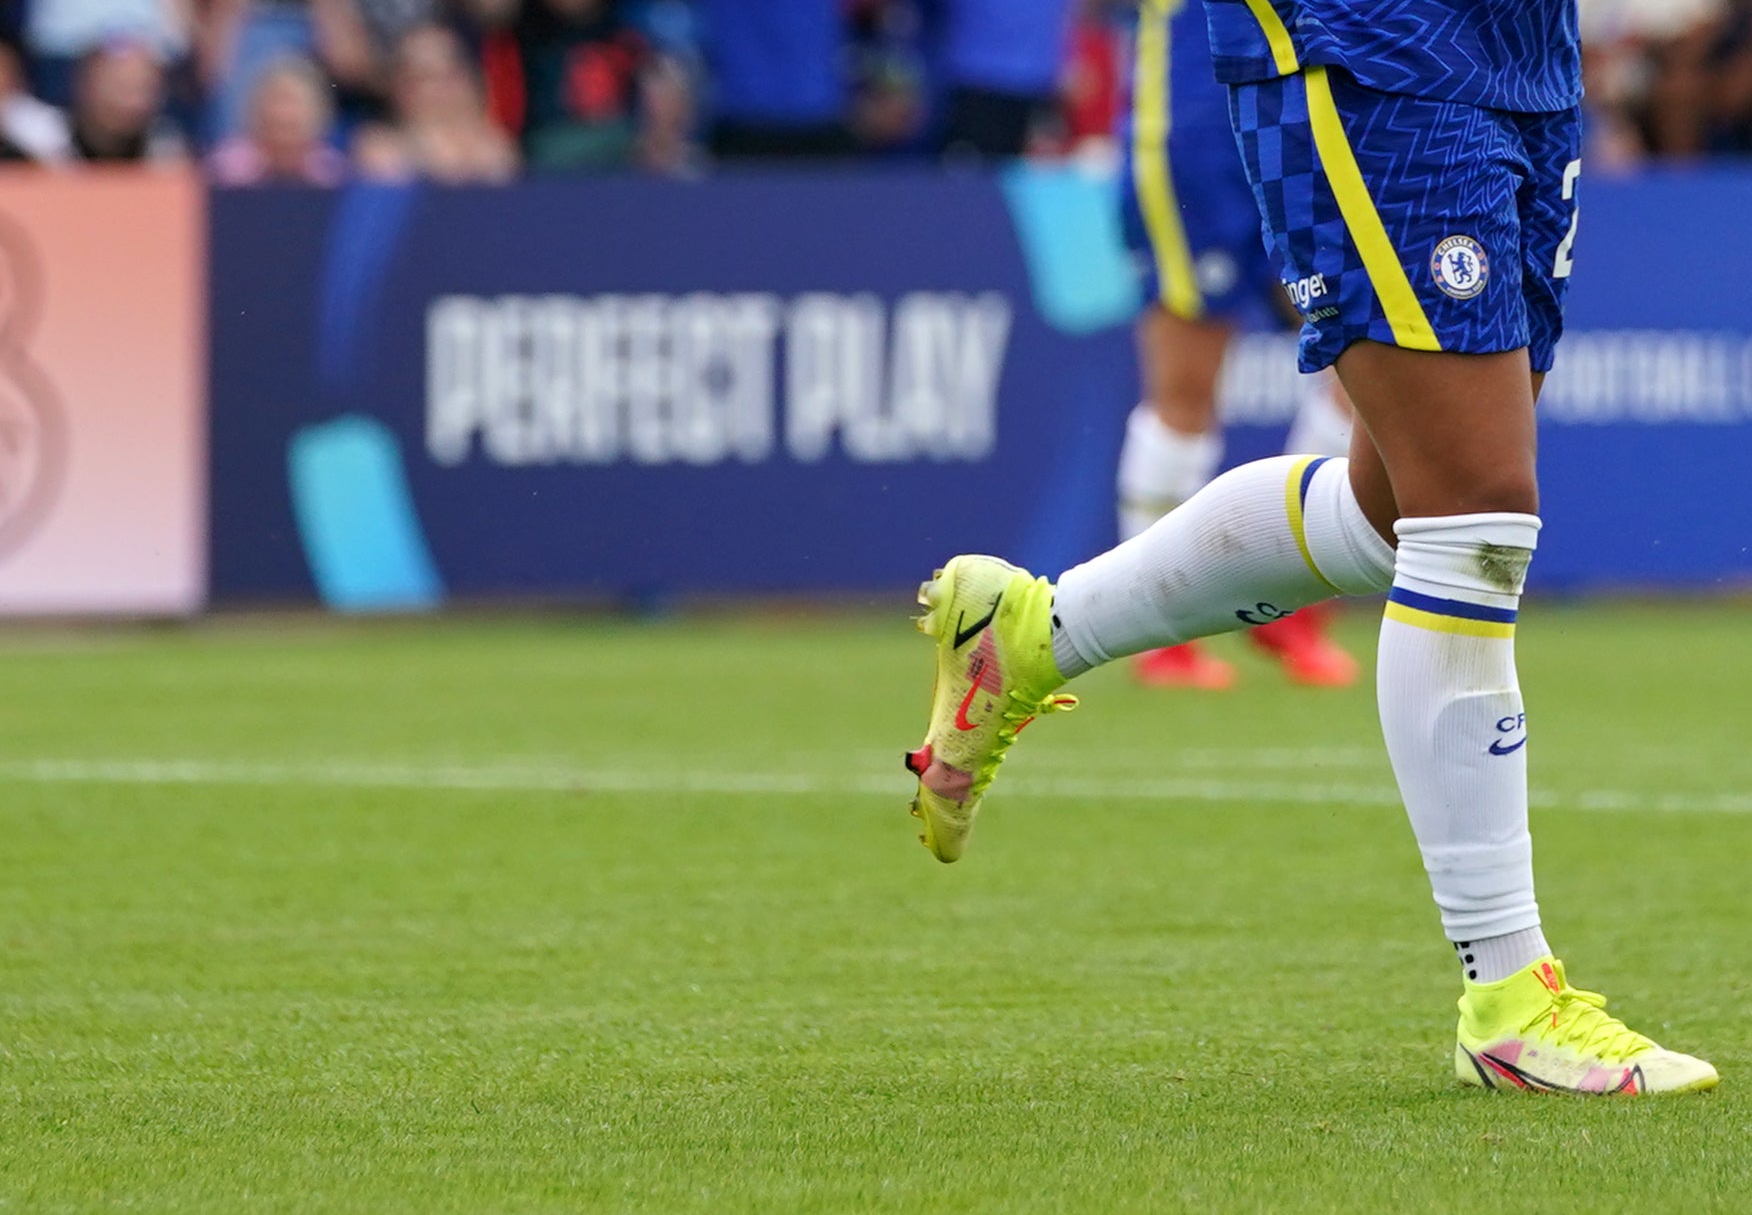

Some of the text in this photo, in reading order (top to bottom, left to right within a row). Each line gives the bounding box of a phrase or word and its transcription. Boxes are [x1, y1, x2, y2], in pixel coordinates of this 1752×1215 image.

[1437, 237, 1474, 256] CHELSEA
[425, 292, 780, 466] PERFECT
[786, 290, 1013, 464] PLAY
